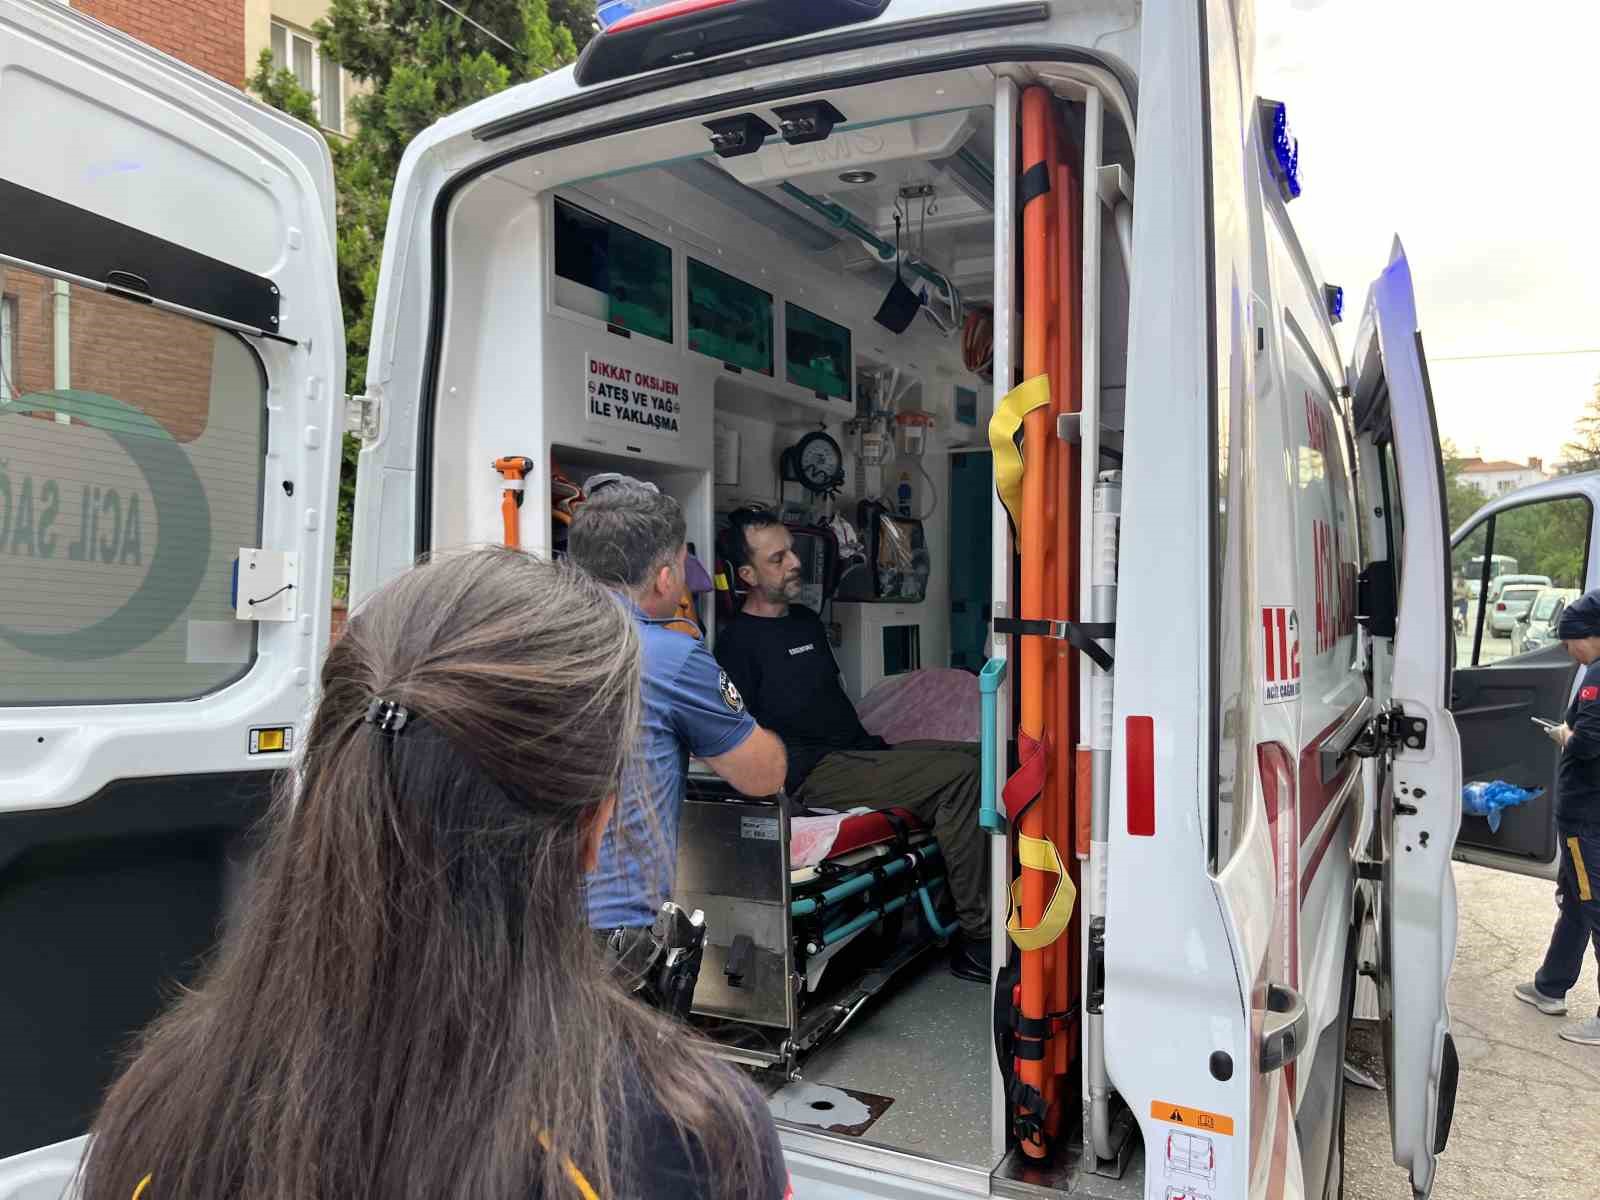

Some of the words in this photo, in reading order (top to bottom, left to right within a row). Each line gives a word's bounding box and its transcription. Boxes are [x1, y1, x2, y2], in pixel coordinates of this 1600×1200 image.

[590, 360, 632, 382] DİKKAT
[598, 382, 628, 403] ATEŞ
[632, 391, 647, 407] VE
[651, 397, 673, 413] YAĞ
[590, 396, 611, 417] İLE
[615, 405, 678, 432] YAKLAŞMA
